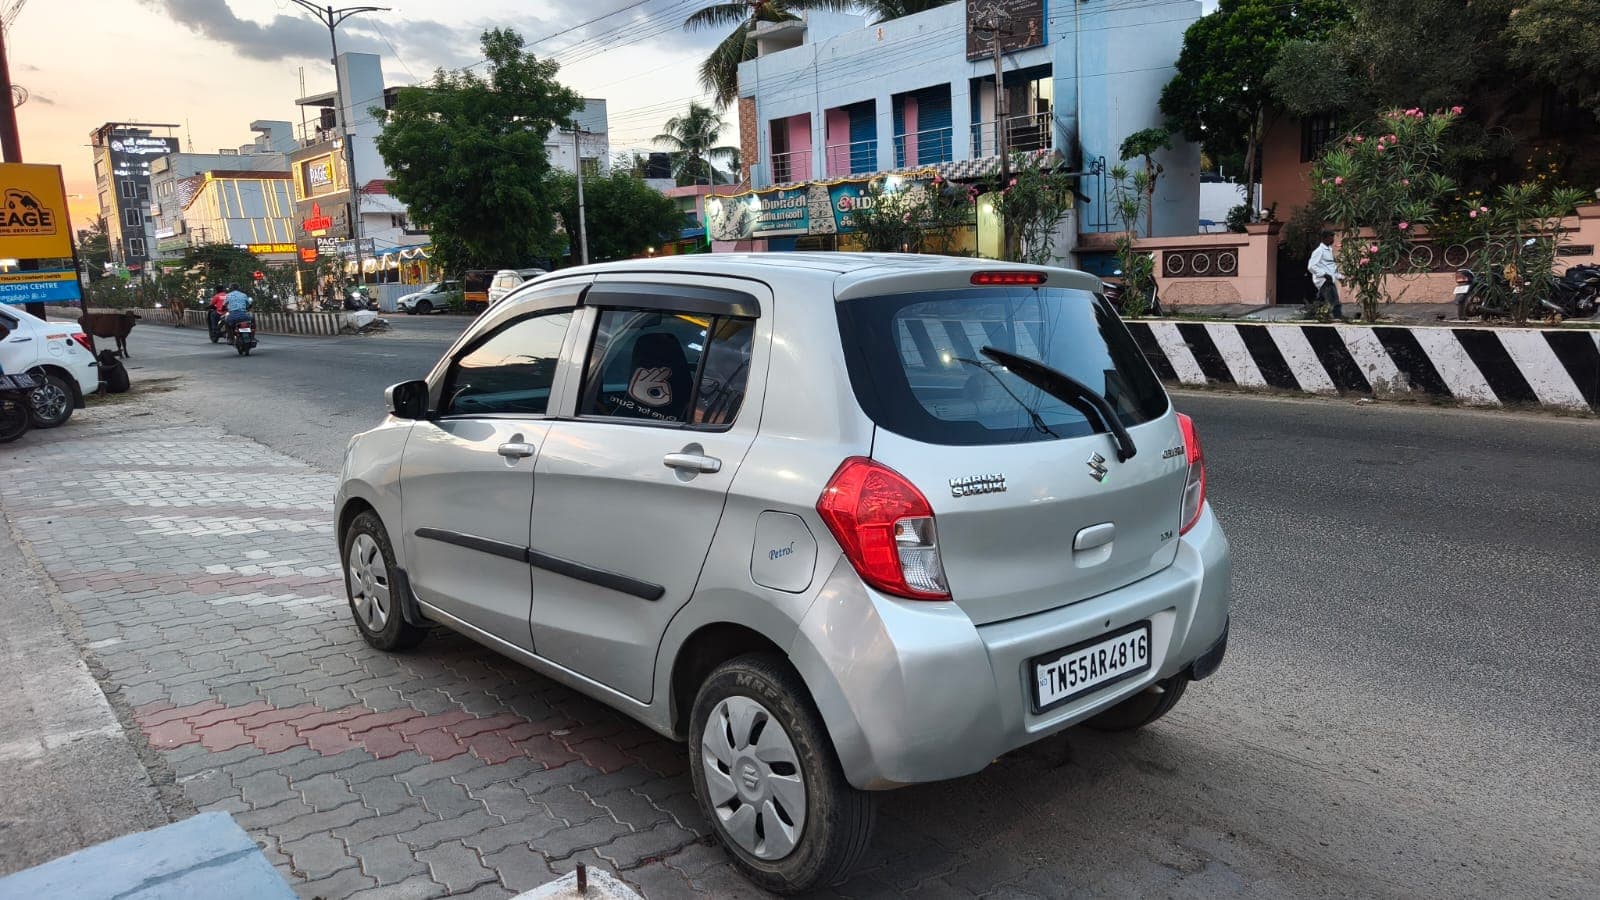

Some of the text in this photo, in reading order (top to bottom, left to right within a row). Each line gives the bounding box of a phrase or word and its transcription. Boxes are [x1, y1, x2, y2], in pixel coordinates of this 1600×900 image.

[949, 472, 1006, 488] MARUTI
[951, 482, 1008, 498] SUZUKI
[768, 541, 795, 561] Petrol
[1047, 635, 1147, 696] TN55AR4816
